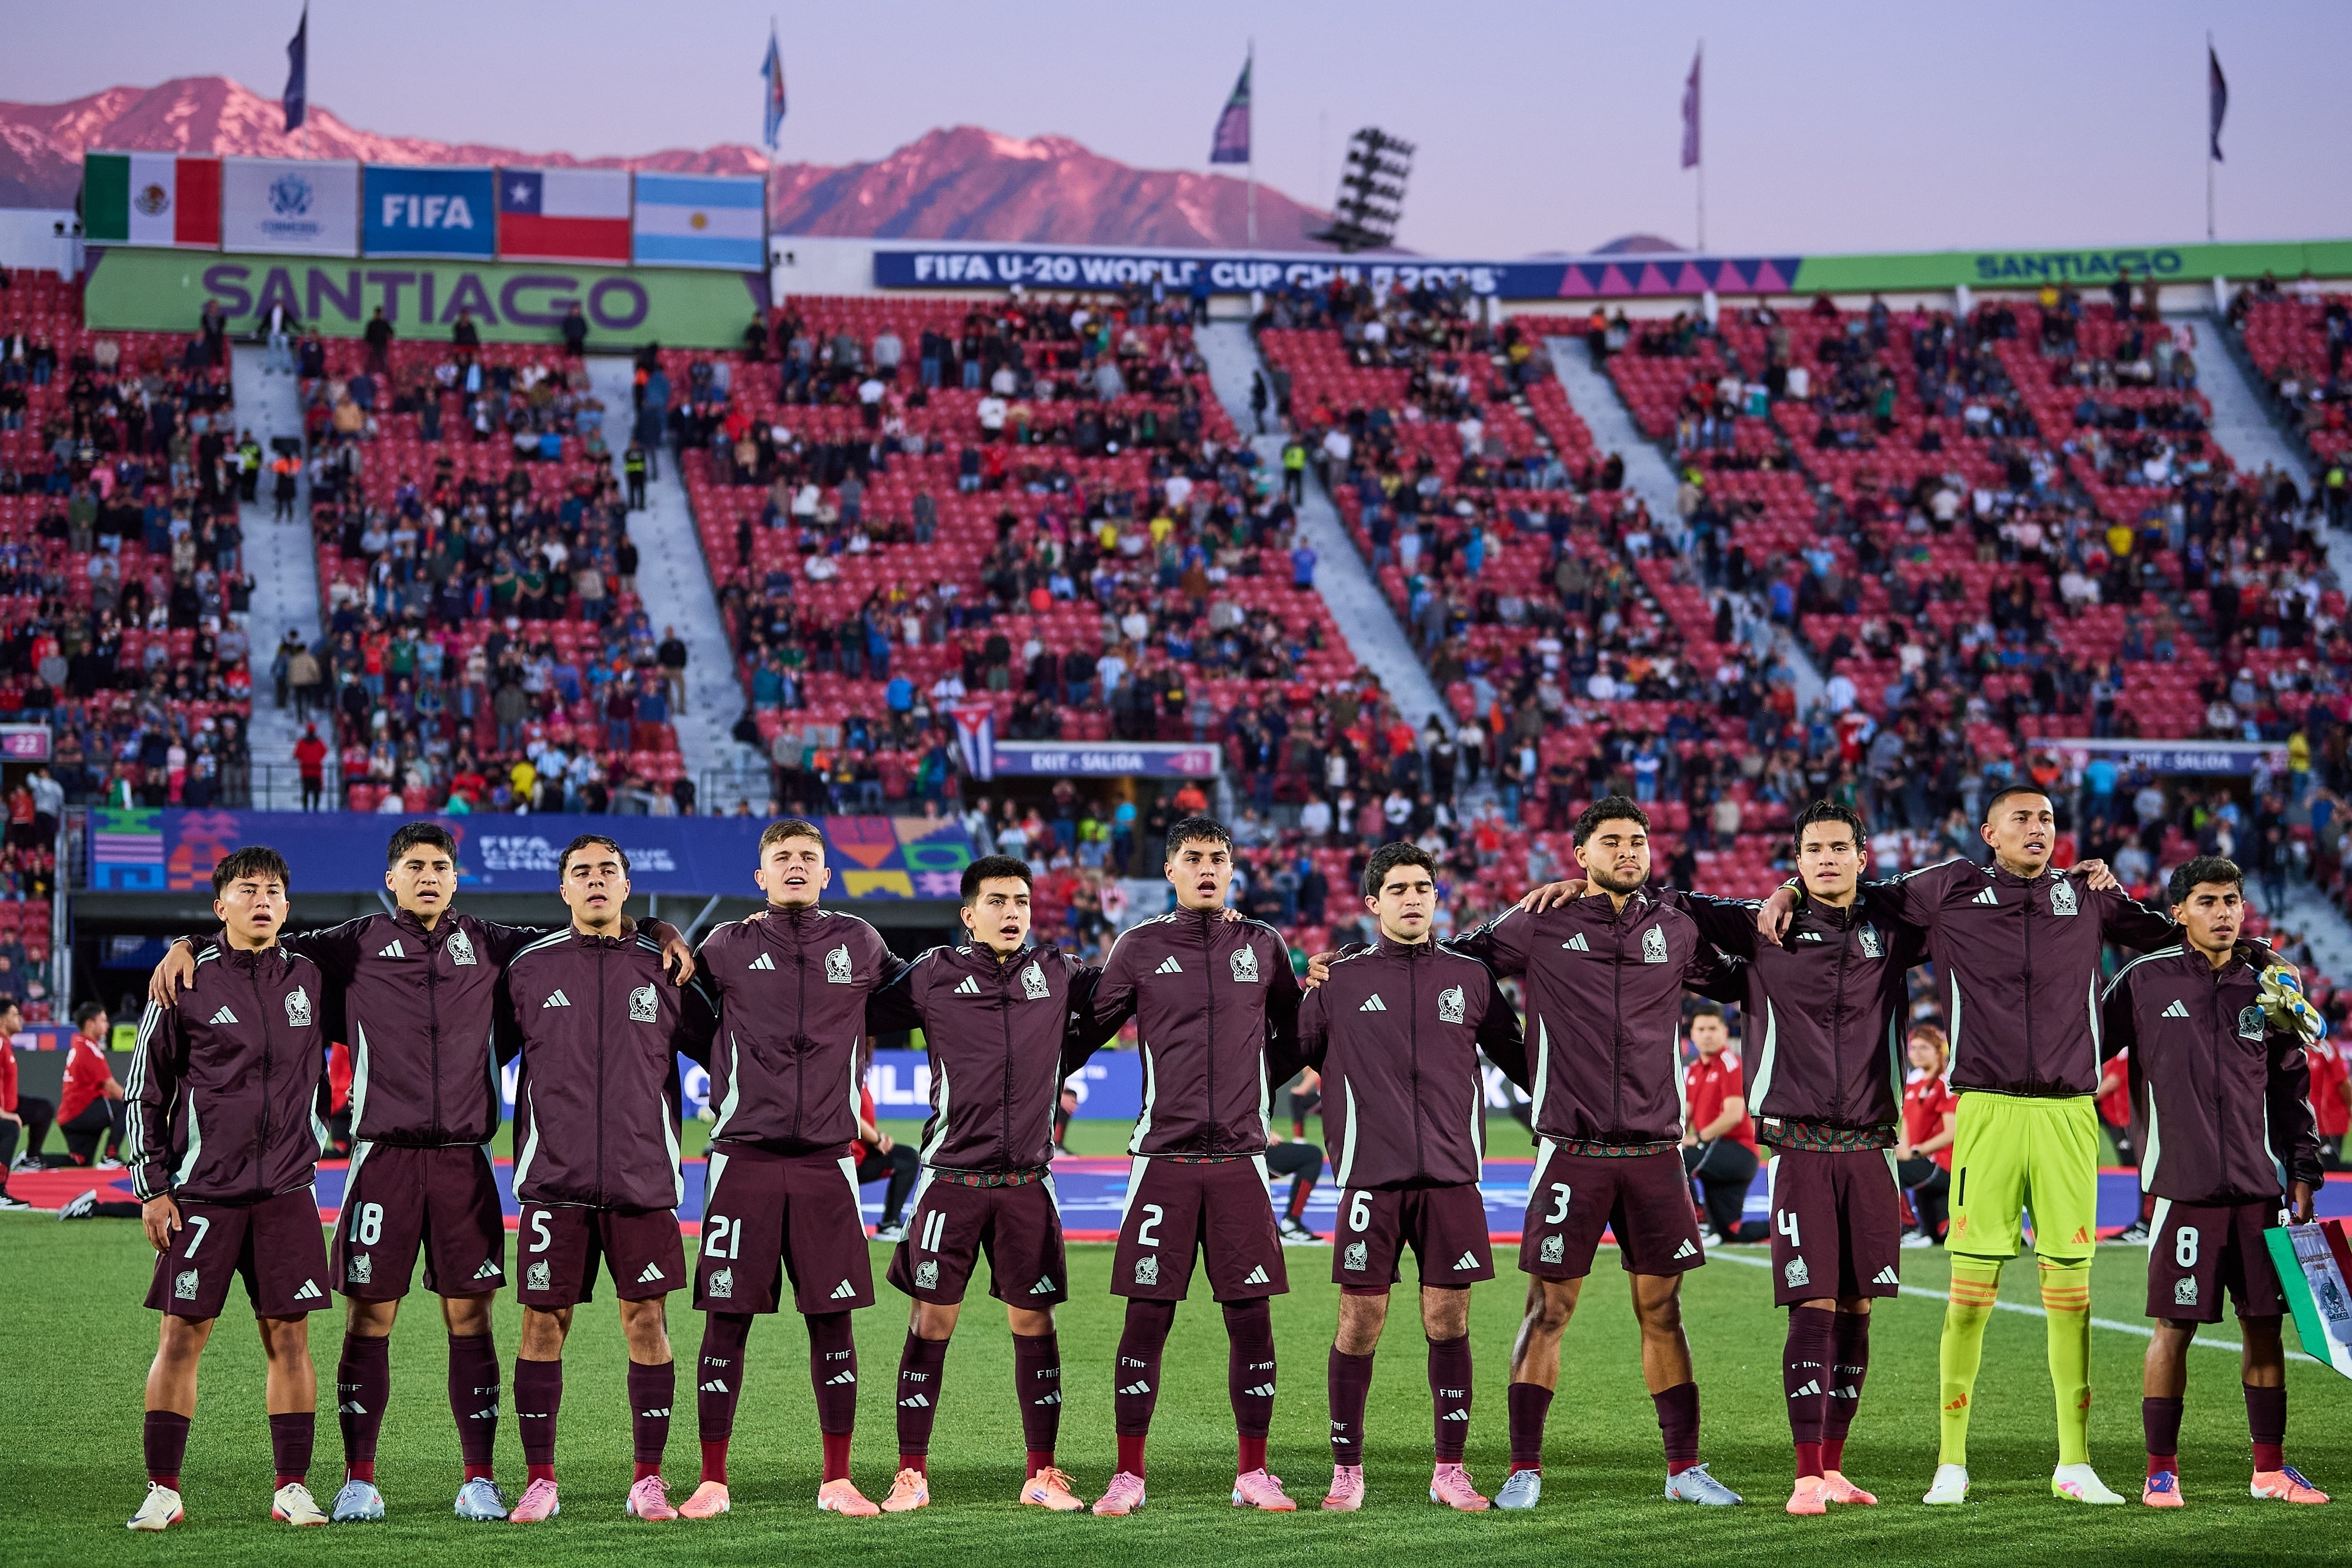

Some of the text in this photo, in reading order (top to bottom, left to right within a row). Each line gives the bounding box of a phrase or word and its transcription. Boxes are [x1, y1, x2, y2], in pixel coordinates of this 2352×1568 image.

[382, 193, 473, 229] FIFA
[914, 255, 994, 281] FIFA
[998, 255, 1077, 282] U-20
[1211, 261, 1281, 287] CUP
[1976, 251, 2182, 279] SANTIAGO
[203, 265, 649, 330] SANTIAGO
[15, 735, 38, 753] 22
[1081, 753, 1144, 771] SALIDA
[1349, 1191, 1372, 1232] 6
[1545, 1183, 1571, 1224] 3
[184, 1216, 209, 1259] 7
[350, 1202, 383, 1246] 18
[530, 1211, 552, 1252] 5
[705, 1215, 741, 1259] 21
[921, 1210, 946, 1253] 11
[1138, 1204, 1162, 1247] 2
[1778, 1209, 1800, 1247] 4
[2176, 1227, 2198, 1268] 8
[704, 1356, 730, 1367] FMF
[826, 1349, 851, 1360] FMF
[903, 1371, 930, 1382] FMF
[1439, 1389, 1465, 1398] FMF
